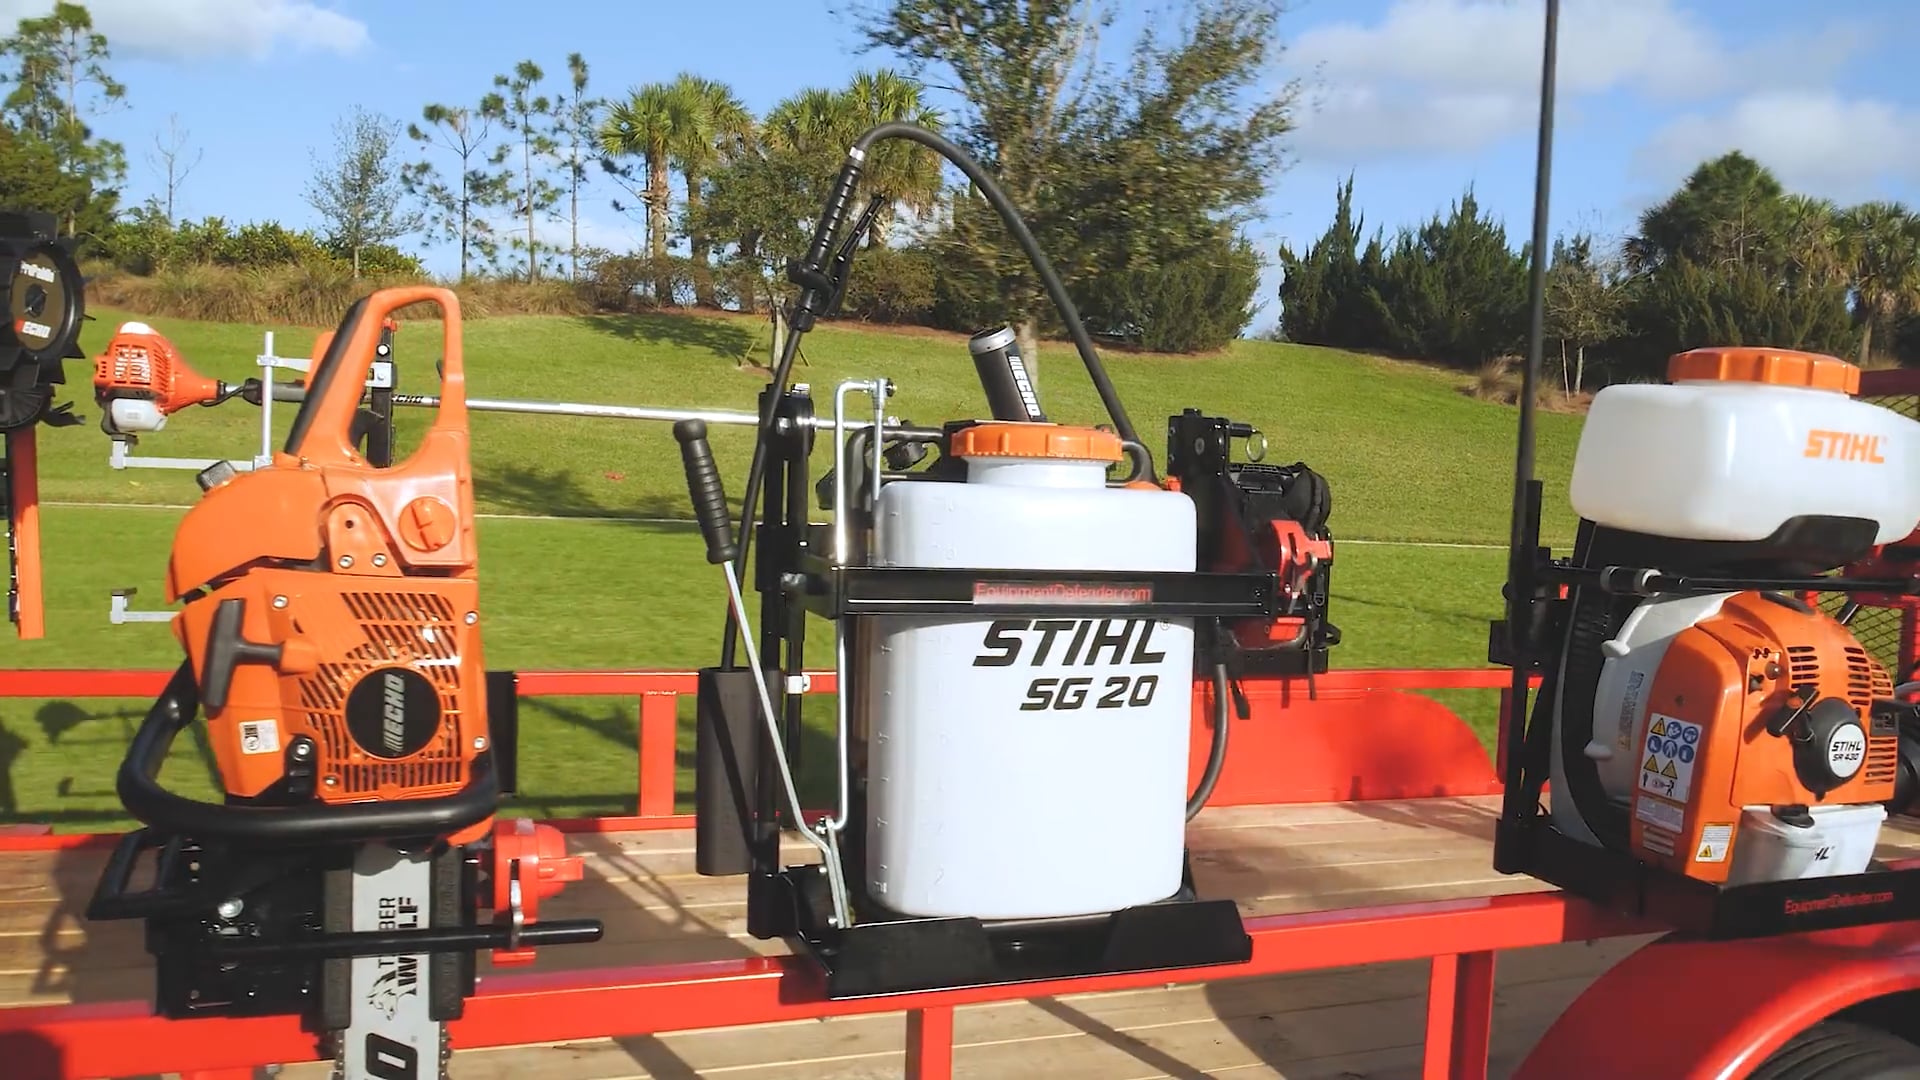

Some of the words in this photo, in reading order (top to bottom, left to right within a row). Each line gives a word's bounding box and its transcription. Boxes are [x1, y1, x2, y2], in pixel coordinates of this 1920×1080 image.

[1803, 428, 1885, 464] STIHL
[974, 581, 1152, 602] EquipmentDefender.com
[972, 619, 1166, 667] STIHL
[1019, 677, 1093, 710] SG
[1096, 674, 1159, 709] 20
[384, 673, 405, 753] ECHO
[1831, 741, 1862, 752] STIHL
[378, 897, 396, 969] TBER
